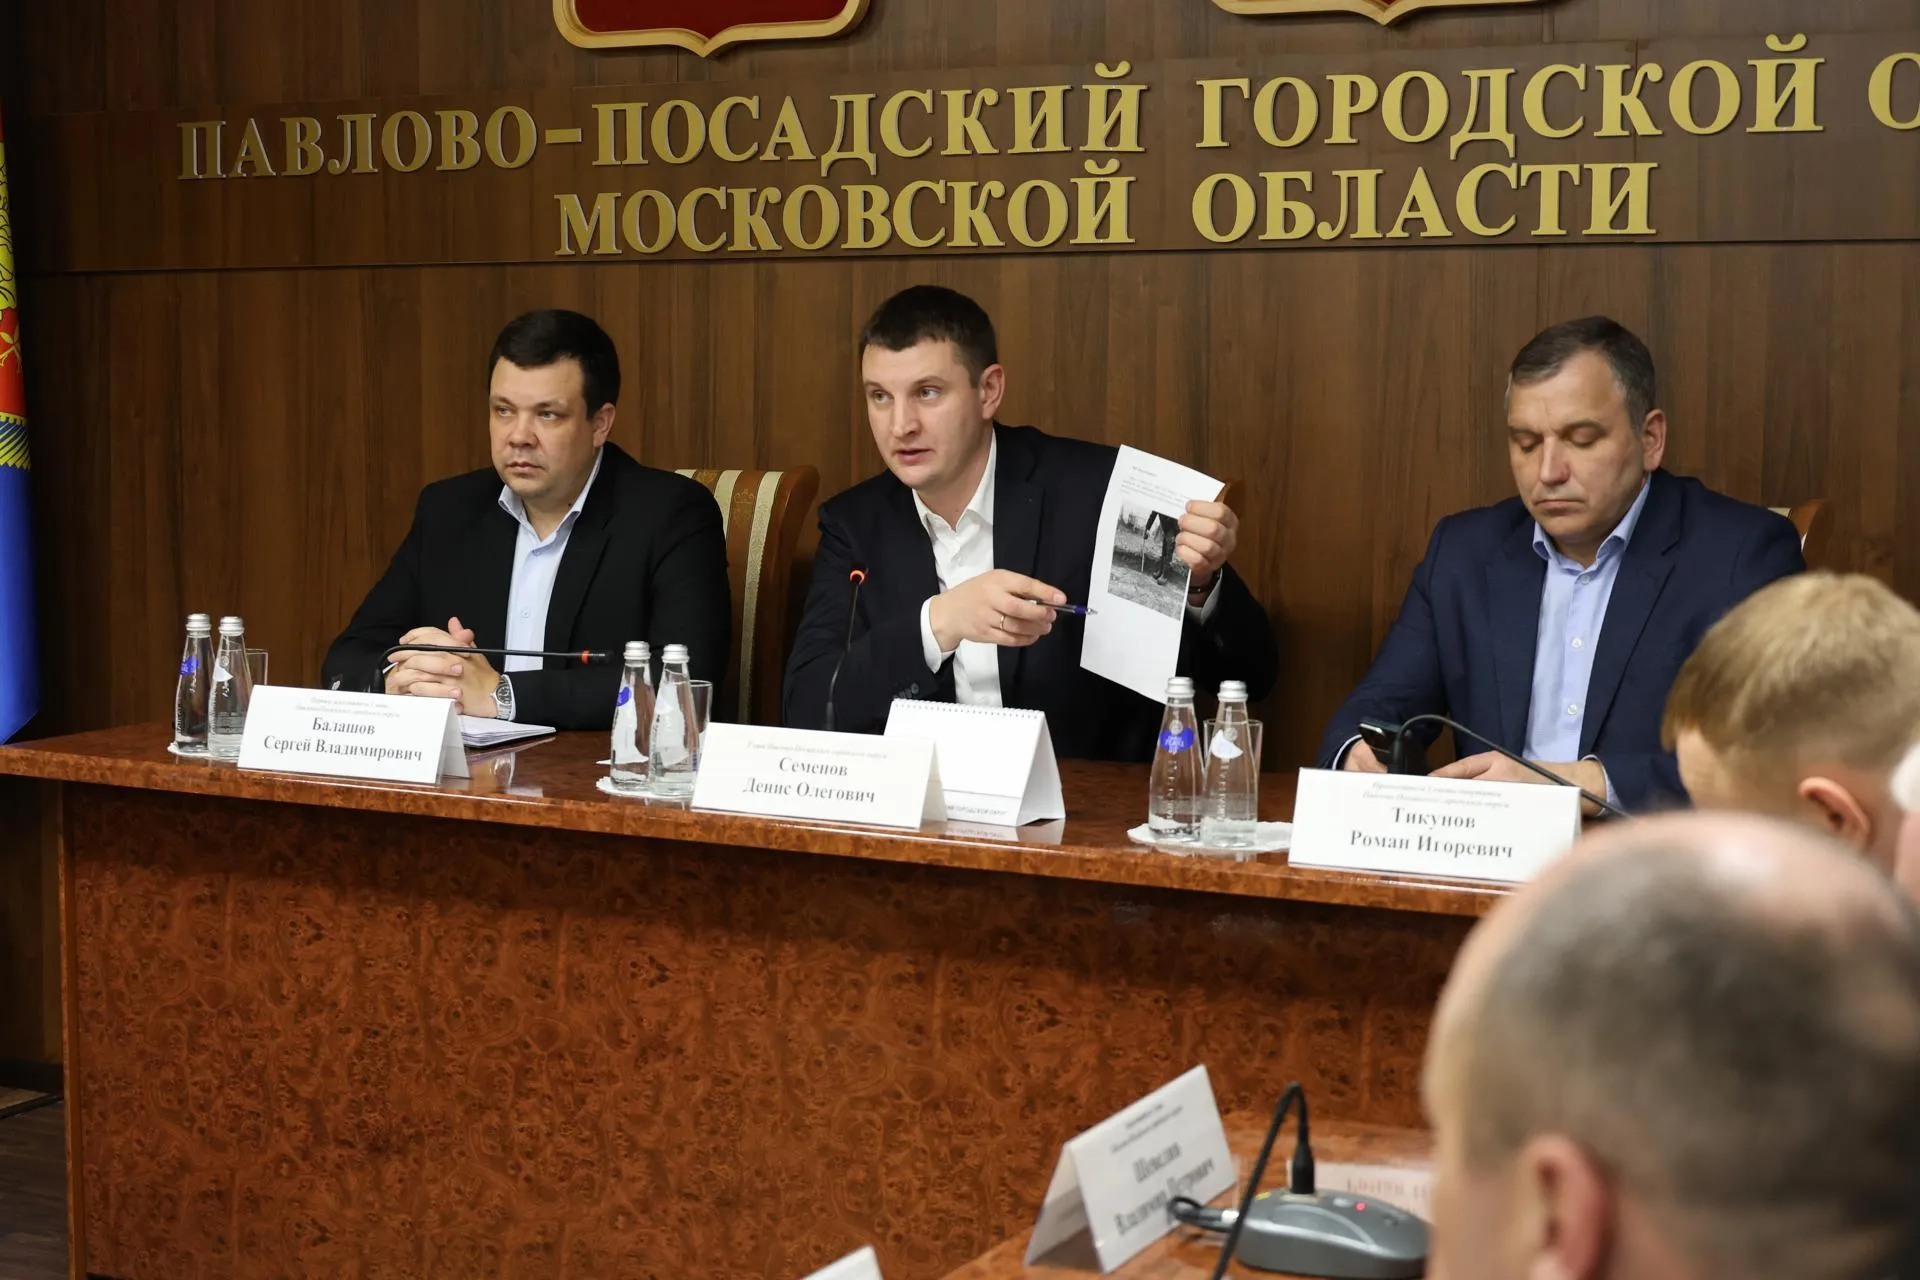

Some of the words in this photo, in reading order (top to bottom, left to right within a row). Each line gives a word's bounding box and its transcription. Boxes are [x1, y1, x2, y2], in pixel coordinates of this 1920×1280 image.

[176, 60, 1149, 181] ПАВЛОВО-ПОСАДСКИЙ
[1195, 33, 1826, 160] ГОРОДСКОЙ
[553, 158, 1138, 256] МОСКОВСКОЙ
[1191, 162, 1659, 243] ОБЛАСТИ
[312, 716, 376, 735] Балашов
[263, 735, 312, 753] Сергей
[315, 738, 423, 762] Владимирович
[779, 756, 849, 776] Семенов
[742, 777, 792, 796] Денис
[796, 781, 875, 803] Олегович
[1391, 806, 1476, 831] Тикунов
[1350, 829, 1410, 850] Роман
[1417, 835, 1513, 858] Игоревич
